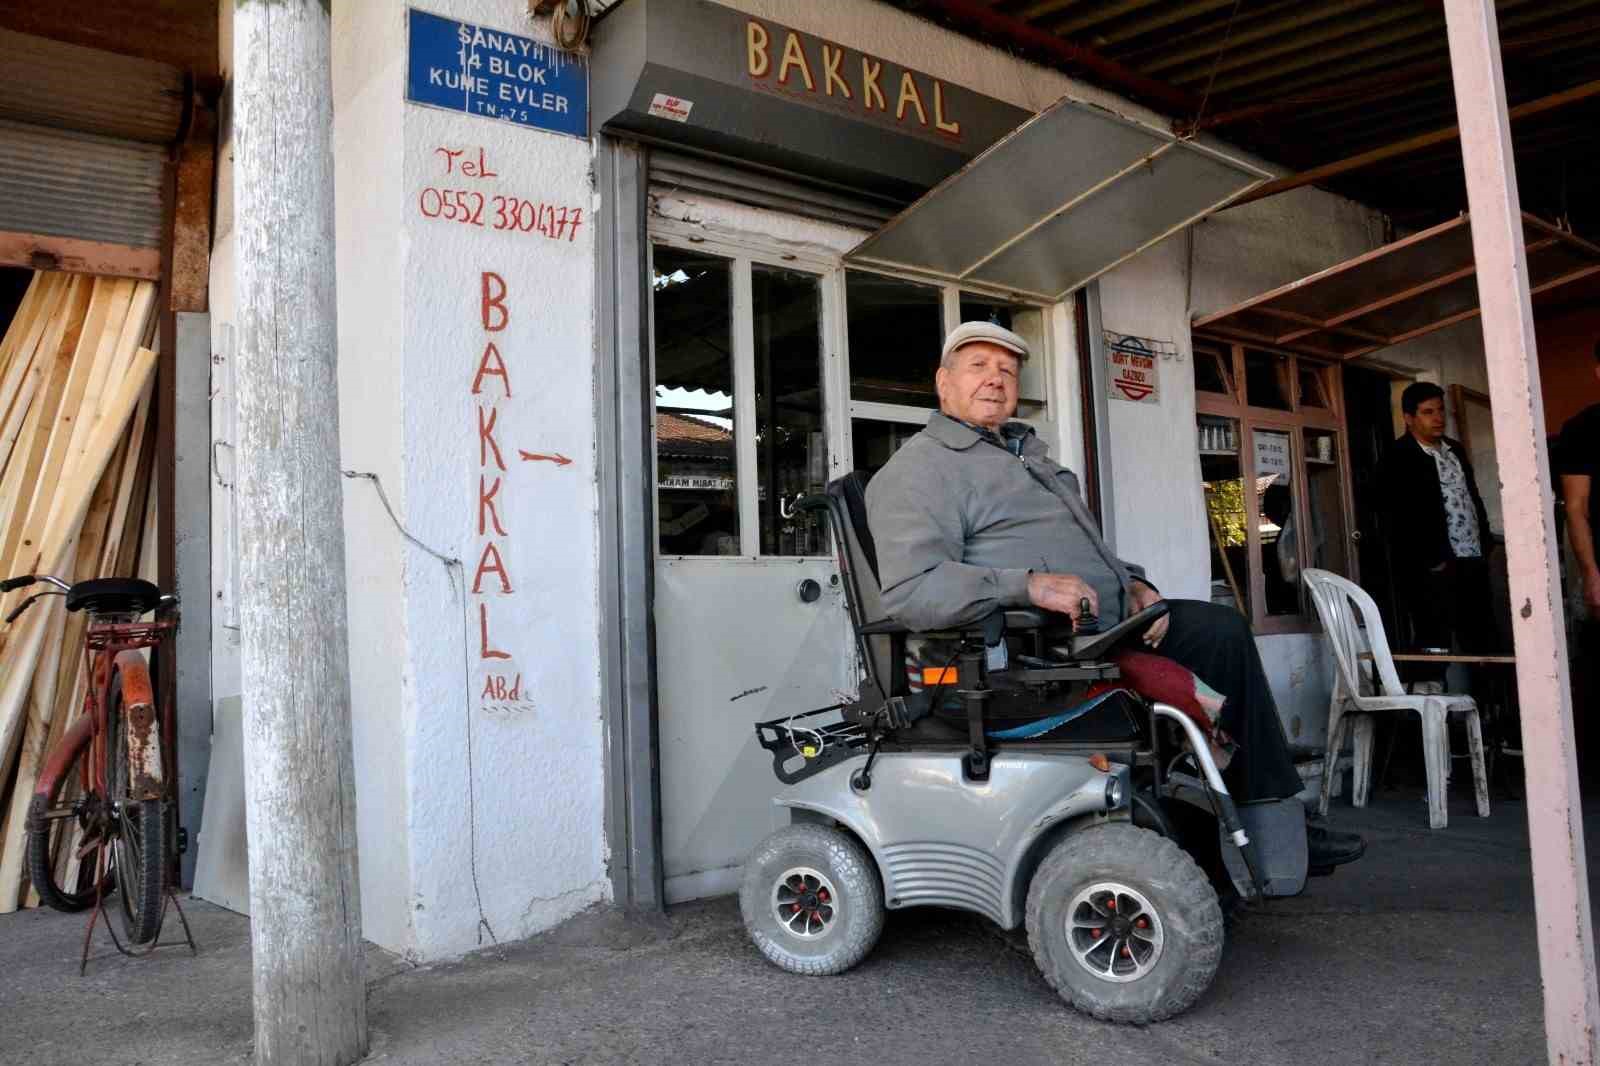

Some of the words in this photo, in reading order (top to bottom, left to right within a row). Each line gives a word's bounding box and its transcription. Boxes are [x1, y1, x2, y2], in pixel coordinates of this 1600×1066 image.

[457, 49, 482, 70] 14
[489, 56, 547, 86] BLOK
[746, 21, 961, 135] BAKKAL
[499, 82, 569, 114] EVLER
[420, 187, 484, 226] 0552
[492, 195, 583, 242] 3304177
[471, 271, 513, 660] BAKKAL
